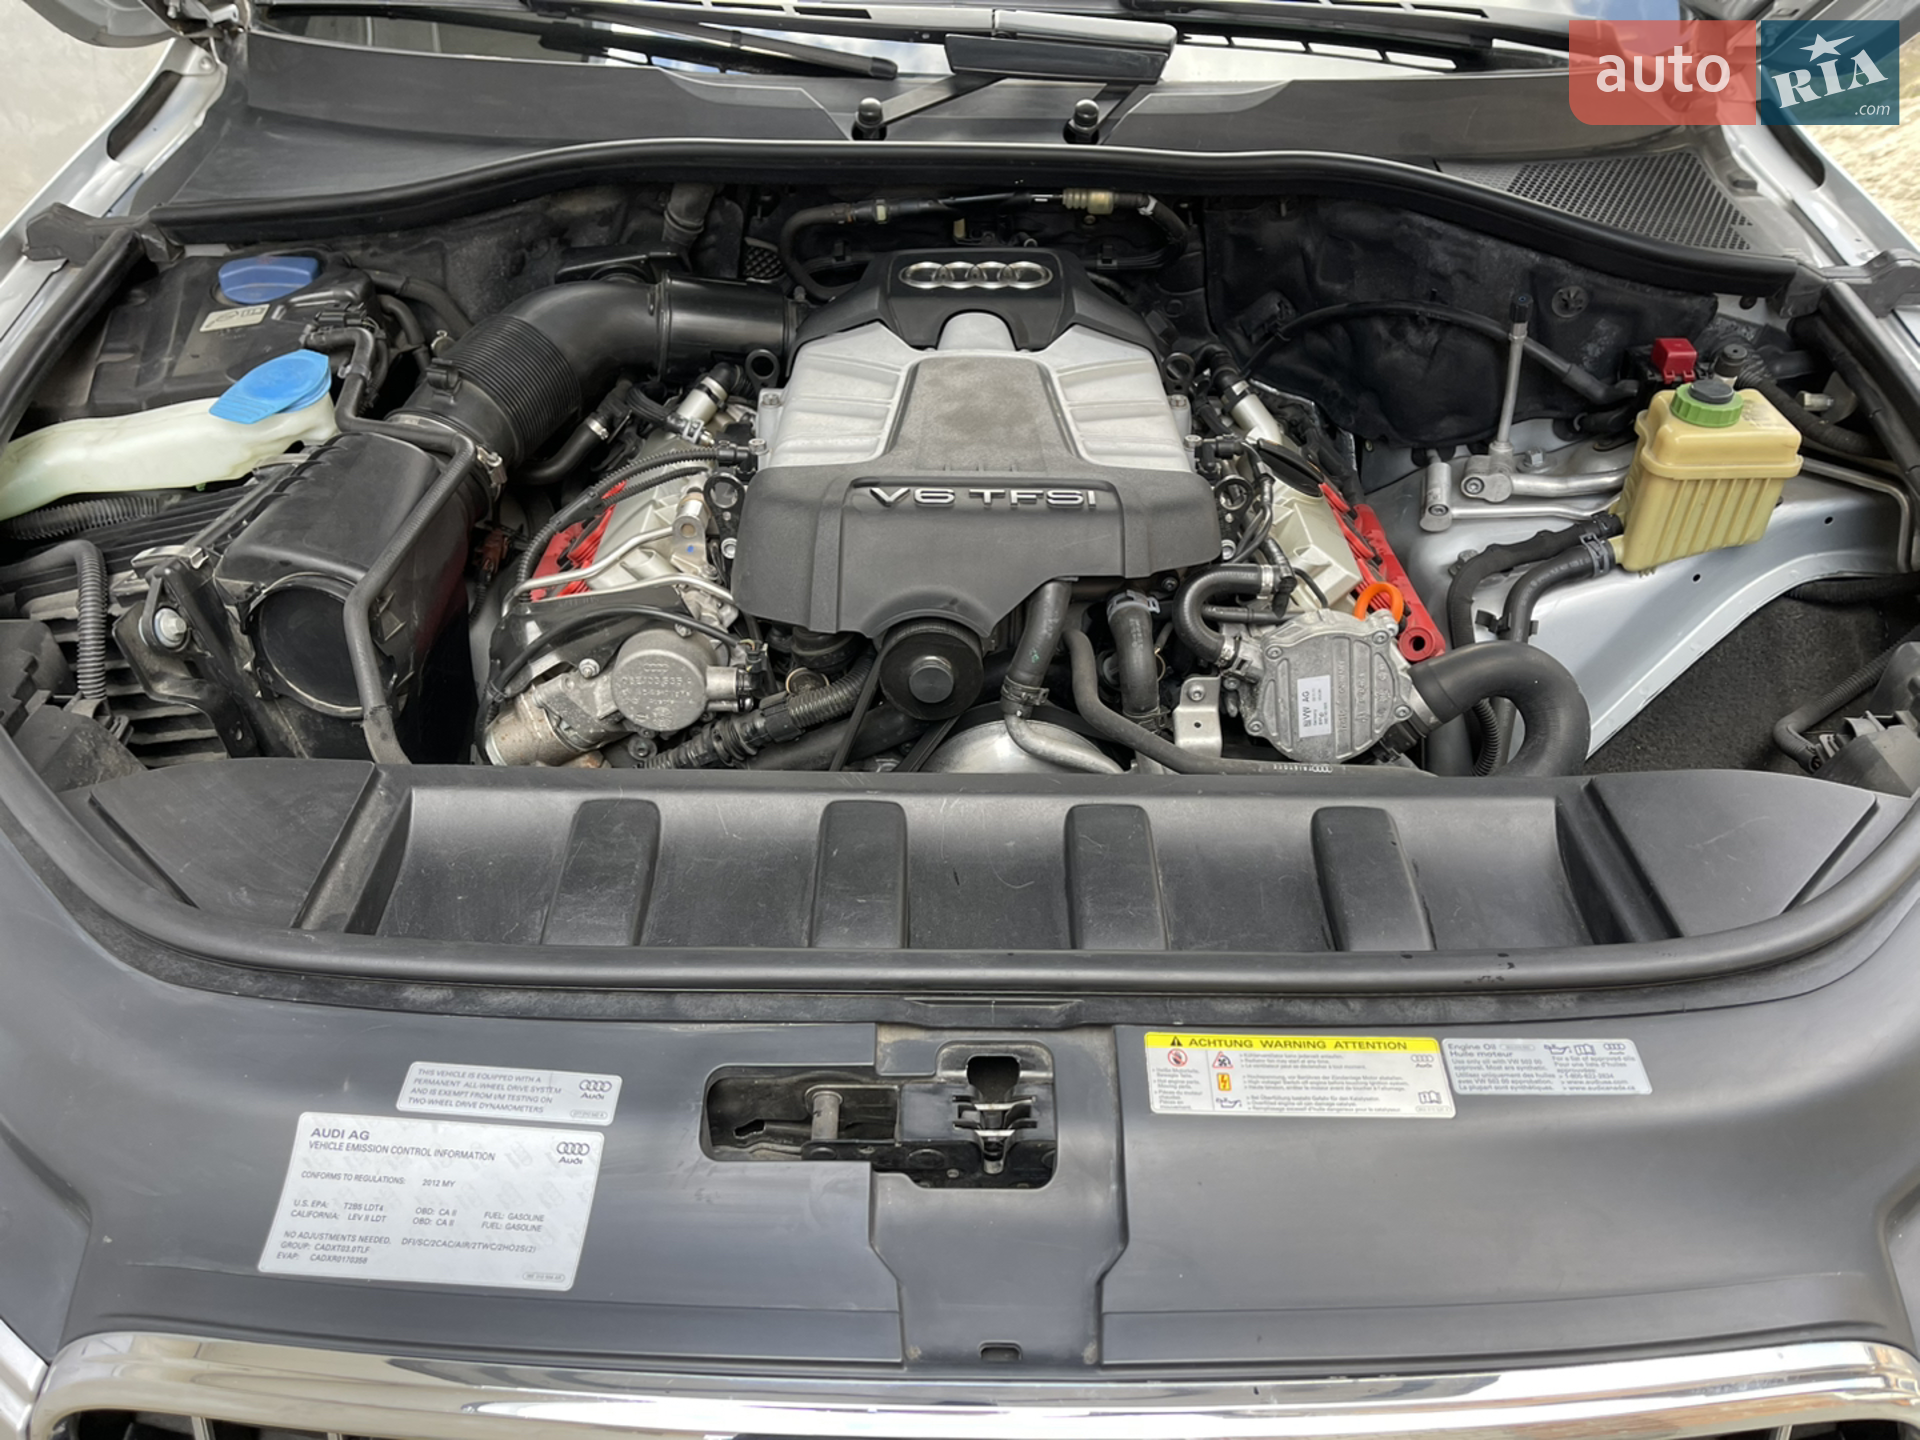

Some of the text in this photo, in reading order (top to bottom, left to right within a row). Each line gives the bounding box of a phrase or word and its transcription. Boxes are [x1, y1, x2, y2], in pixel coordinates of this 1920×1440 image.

[868, 487, 1097, 509] V6 TFSI
[1189, 1038, 1407, 1051] ACHTUNG WARNING ATTENTION
[1448, 1044, 1480, 1052] Engine
[1483, 1043, 1496, 1051] Oil
[418, 1068, 435, 1077] THIS
[437, 1070, 465, 1079] VEHICLE
[467, 1072, 475, 1080] IS
[477, 1073, 513, 1082] EQUIPPED
[515, 1075, 534, 1083] WITH
[414, 1078, 461, 1088] PERMANENT
[507, 1084, 528, 1092] DRIVE
[530, 1086, 562, 1094] SYSTEM
[410, 1087, 428, 1095] AND
[438, 1090, 468, 1098] EXEMPT
[470, 1092, 493, 1100] FROM
[507, 1094, 538, 1102] TESTING
[540, 1096, 553, 1104] ON
[580, 1091, 605, 1100] Audi
[455, 1100, 477, 1109] DRIVE
[479, 1102, 544, 1113] DYNAMOMETERS
[310, 1128, 370, 1141] AUDI AG
[309, 1140, 496, 1161] VEHICLE EMISSION CONTROL INFORMATION
[558, 1155, 583, 1165] Audi
[301, 1170, 406, 1184] CONFORMS TO REGULATIONS:
[422, 1179, 456, 1188] 2012 MY
[293, 1199, 328, 1209] U.S. EPA:
[363, 1203, 384, 1212] LDT4
[291, 1209, 340, 1220] CALIFORNIA:
[415, 1207, 434, 1216] OBD:
[439, 1208, 450, 1217] CA
[484, 1211, 544, 1223] FUEL: GASOLINE
[348, 1213, 362, 1221] LEV
[370, 1215, 387, 1223] LDT
[412, 1217, 431, 1226] OBD:
[436, 1218, 447, 1227] CA
[481, 1221, 542, 1233] FUEL: GASOLINE
[284, 1231, 391, 1245] NO ADJUSTMENTS NEEDED.
[281, 1241, 310, 1250] GROUP:
[276, 1251, 299, 1261] EVAP:
